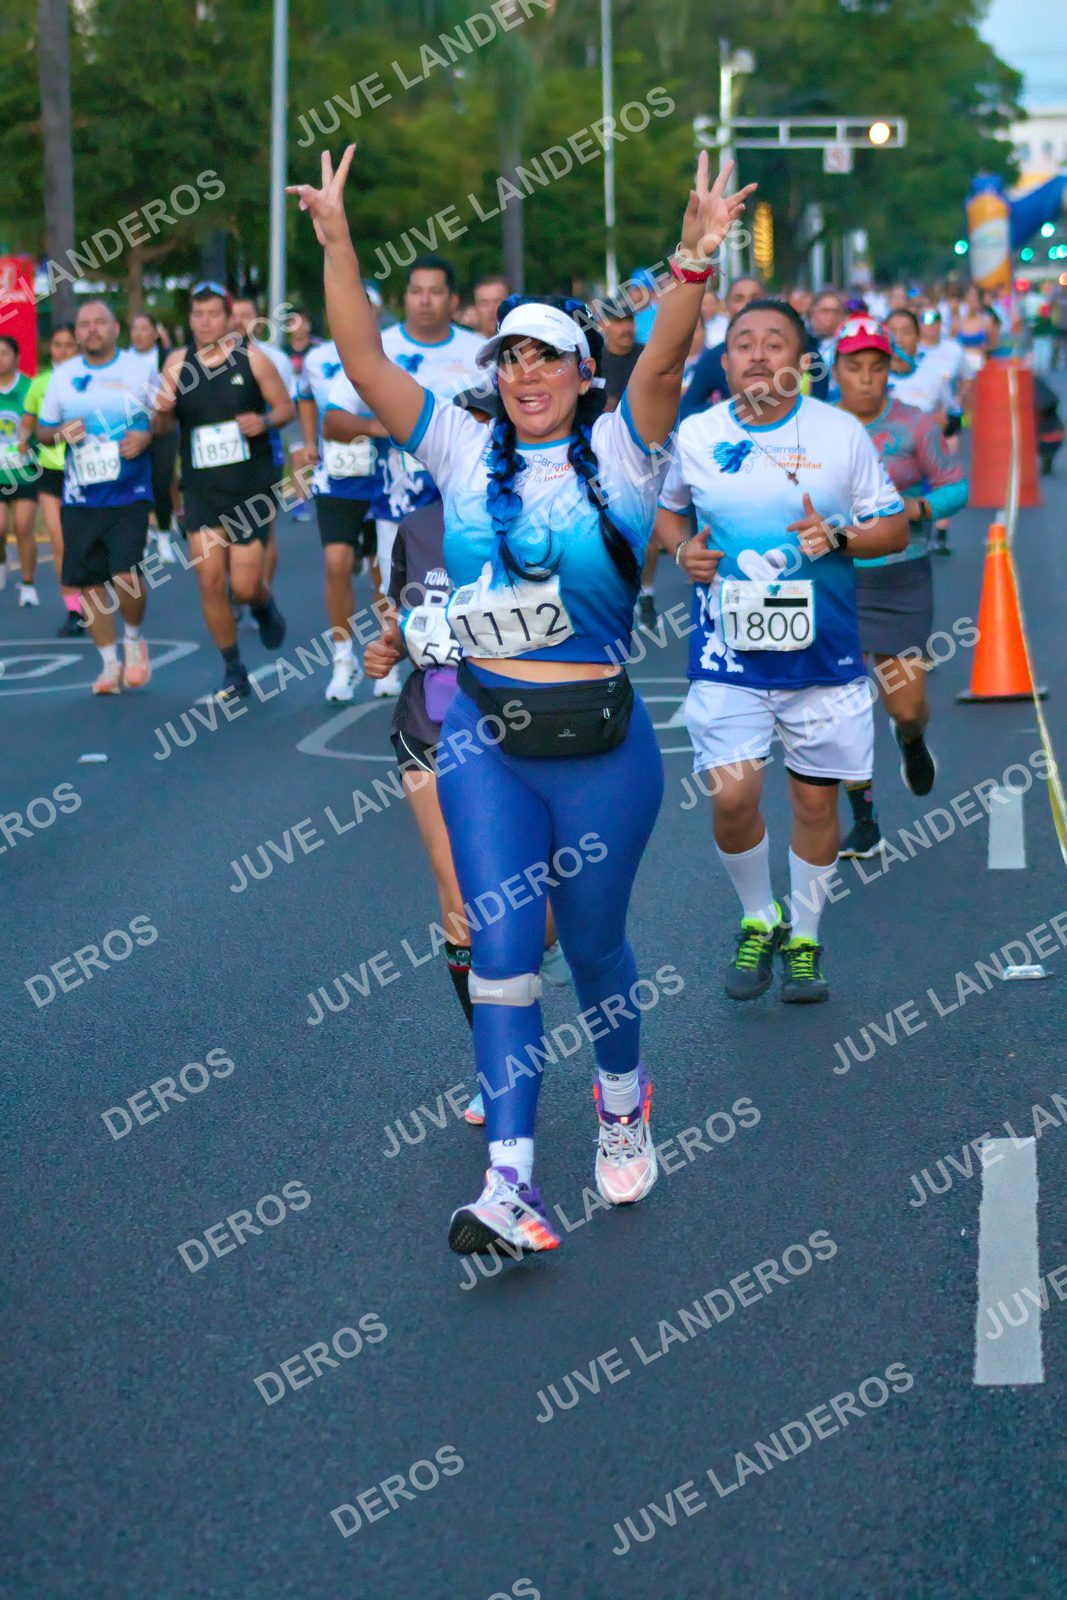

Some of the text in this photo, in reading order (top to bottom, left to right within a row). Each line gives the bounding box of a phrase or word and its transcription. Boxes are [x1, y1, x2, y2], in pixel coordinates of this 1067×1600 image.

[198, 440, 240, 465] 1857
[78, 459, 118, 481] 1839
[457, 602, 567, 646] 1112
[729, 611, 811, 642] 1800
